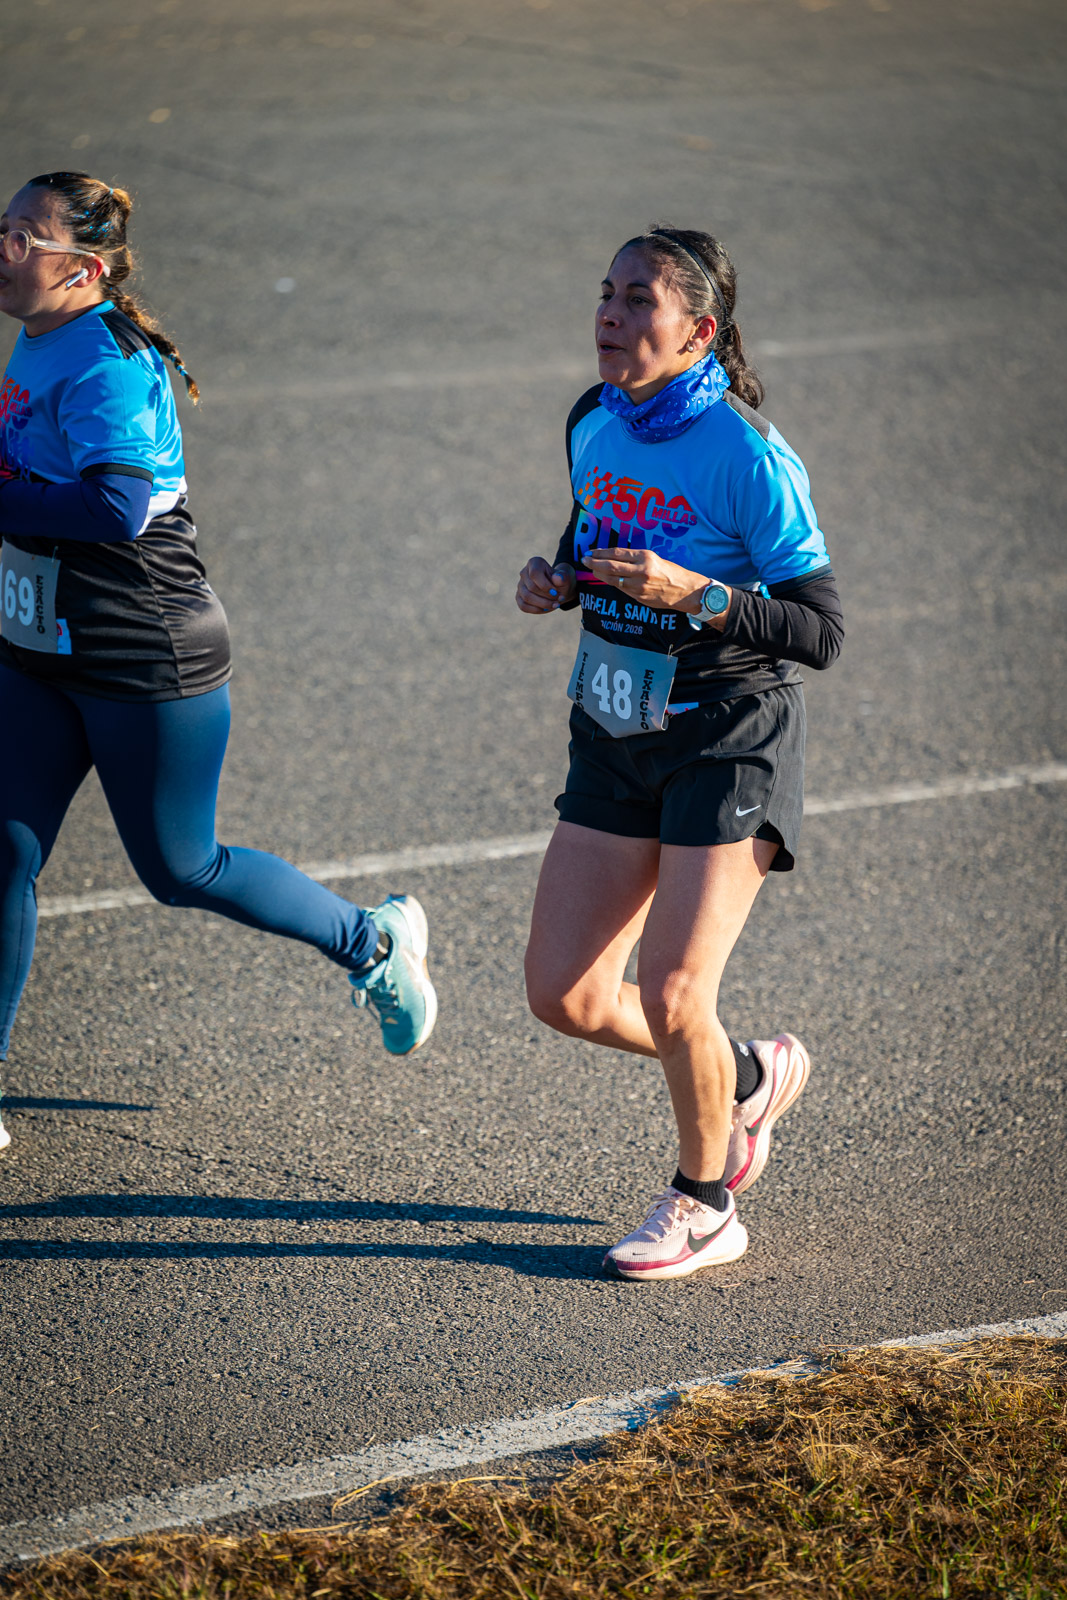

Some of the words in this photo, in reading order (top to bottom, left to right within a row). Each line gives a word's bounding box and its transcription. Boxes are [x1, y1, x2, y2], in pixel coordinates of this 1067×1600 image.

[651, 506, 698, 526] MILLAS
[0, 562, 35, 626] 69
[36, 574, 45, 634] EXACTO
[624, 602, 658, 625] SANA
[661, 614, 677, 630] FE
[624, 623, 644, 635] 2026
[591, 662, 632, 720] 48
[640, 668, 655, 731] EXACTO
